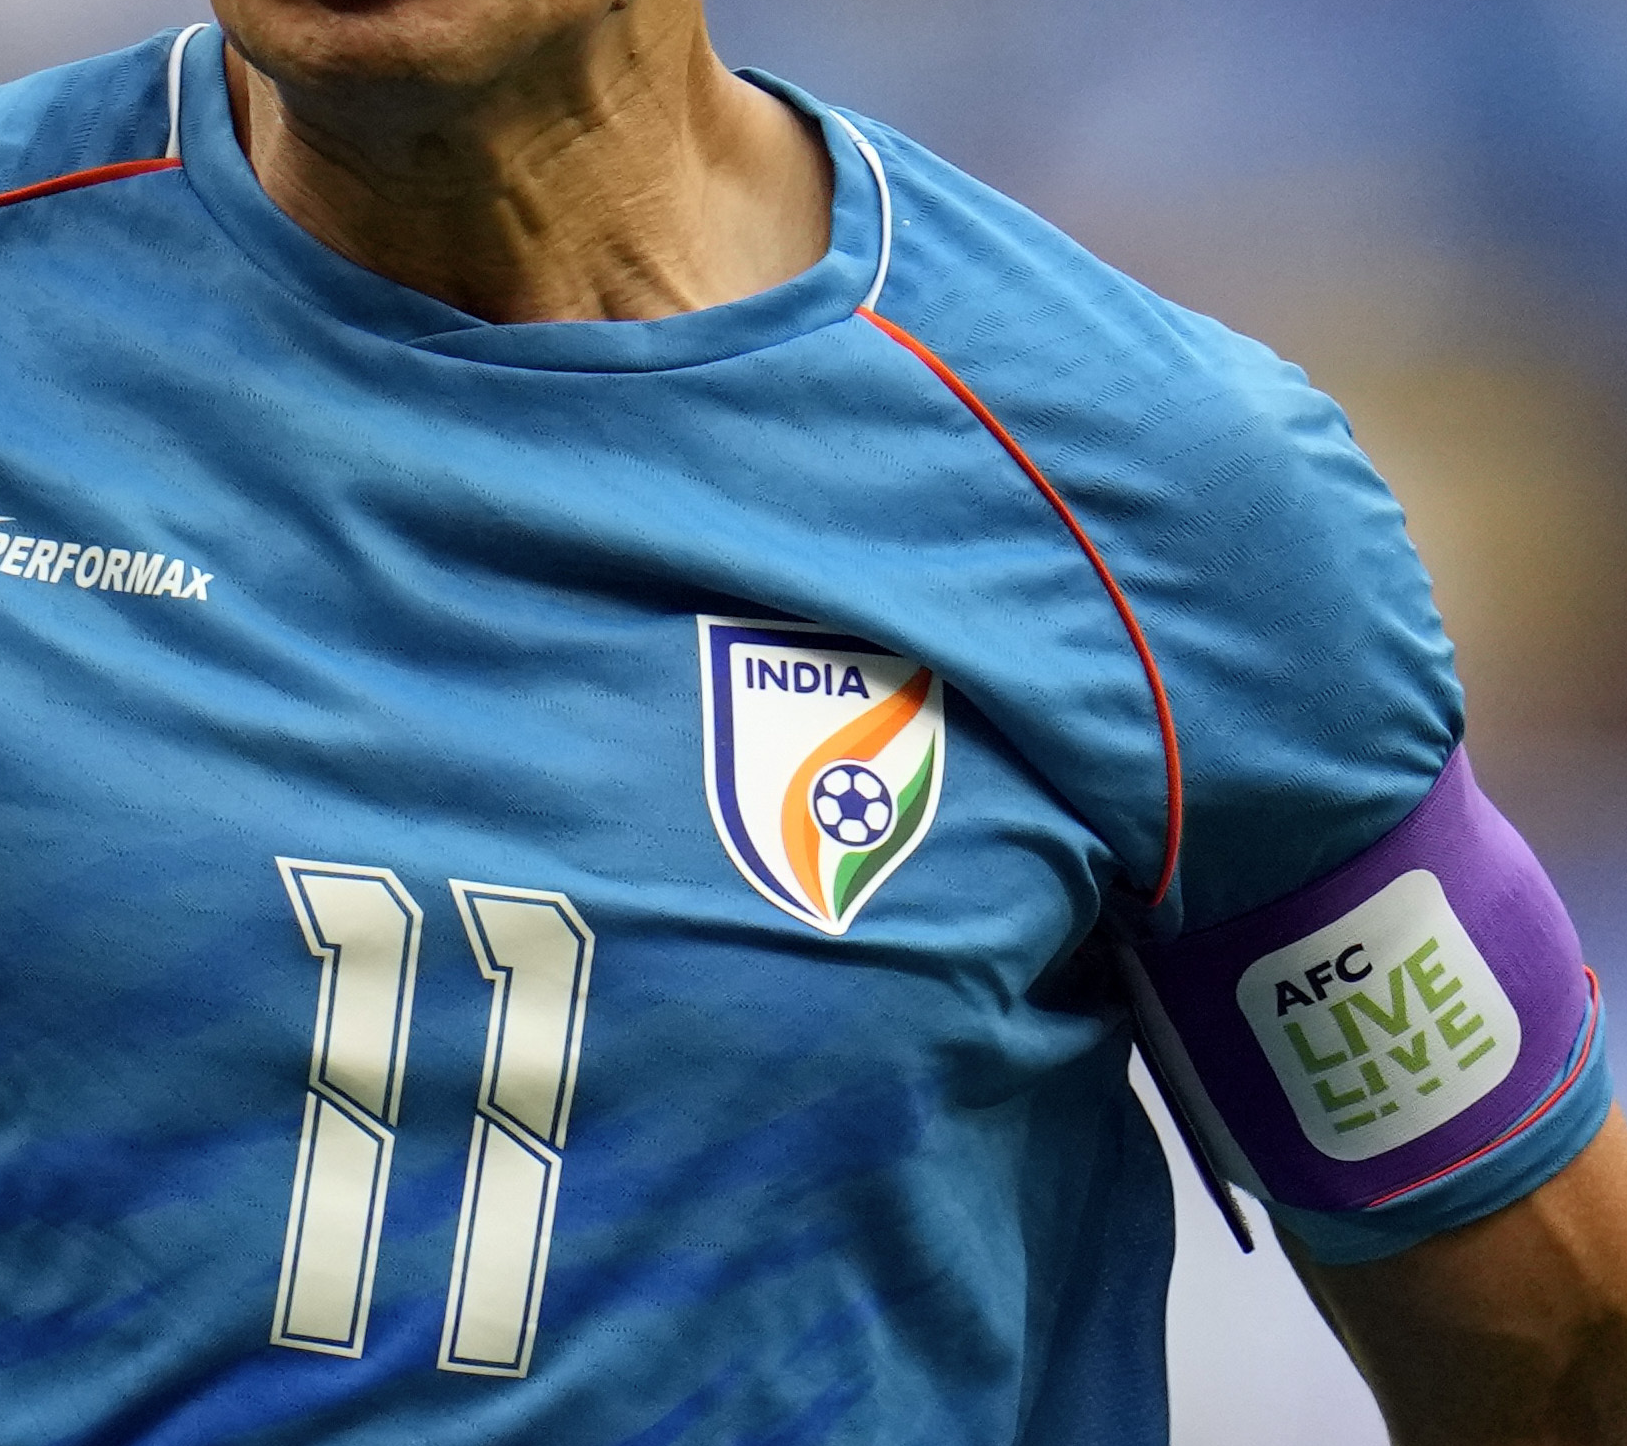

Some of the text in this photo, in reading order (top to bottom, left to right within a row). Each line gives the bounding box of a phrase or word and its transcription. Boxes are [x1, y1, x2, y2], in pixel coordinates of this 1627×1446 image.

[745, 657, 870, 699] INDIA
[1274, 943, 1373, 1017] AFC
[1283, 936, 1464, 1075] LIVE
[269, 856, 596, 1379] 11
